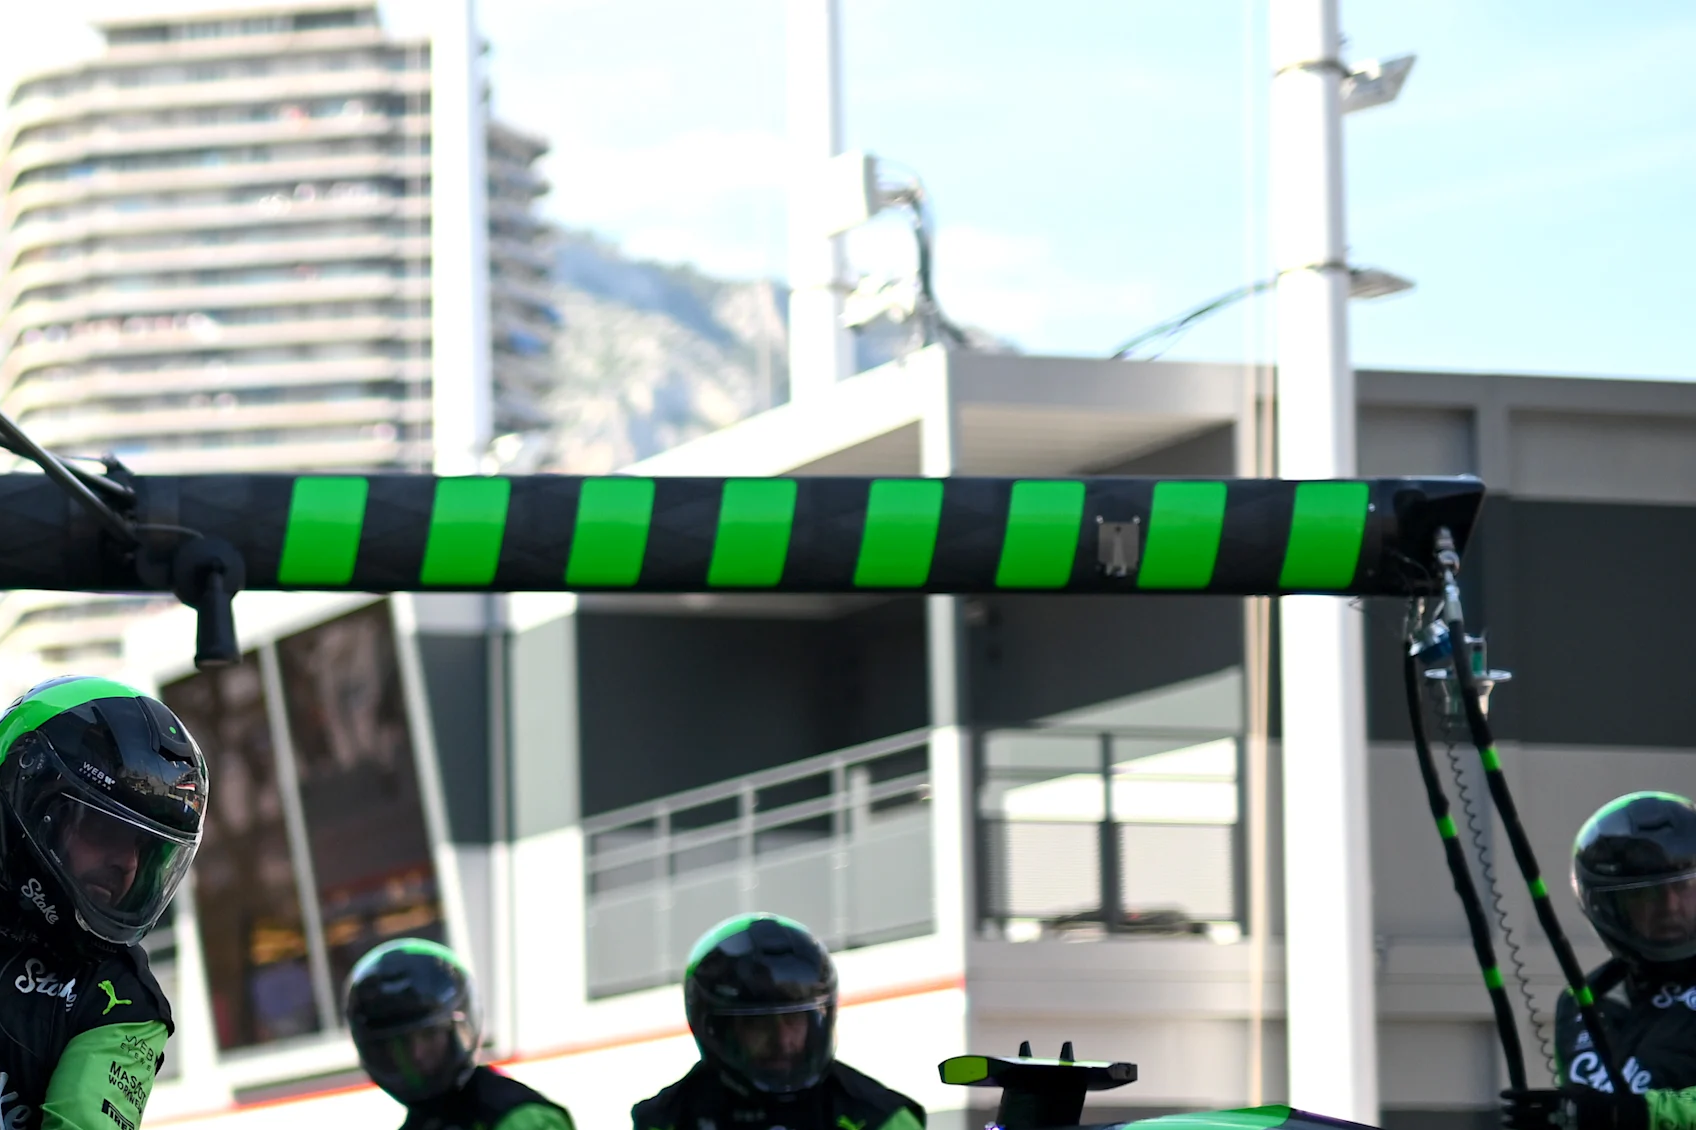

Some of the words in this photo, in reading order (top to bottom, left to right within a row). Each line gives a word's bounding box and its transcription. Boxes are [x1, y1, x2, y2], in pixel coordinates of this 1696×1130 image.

[82, 761, 105, 780] WEB
[20, 877, 59, 925] Stake
[124, 1034, 154, 1062] WEB
[109, 1060, 147, 1101] MASCOT
